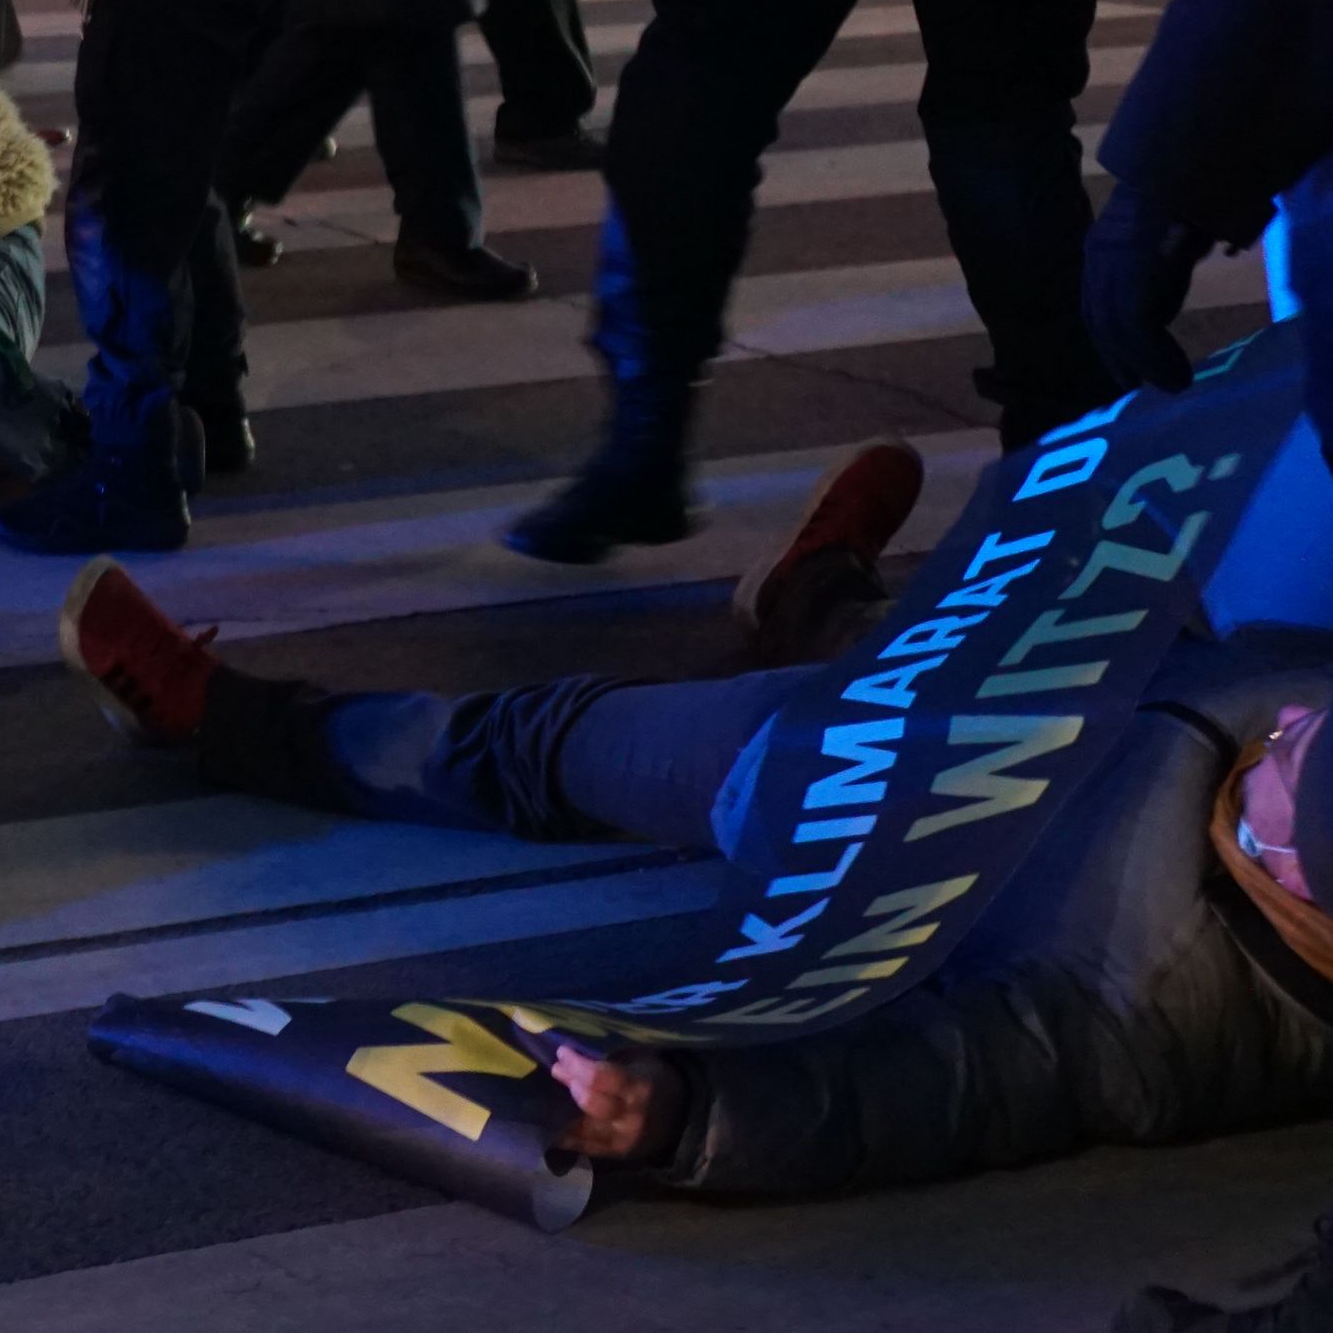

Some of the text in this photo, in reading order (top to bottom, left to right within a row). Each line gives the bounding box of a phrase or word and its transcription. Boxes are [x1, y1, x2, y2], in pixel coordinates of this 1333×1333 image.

[694, 452, 1242, 1025] EIN WITZ?
[715, 529, 1058, 964] KLIMARAT
